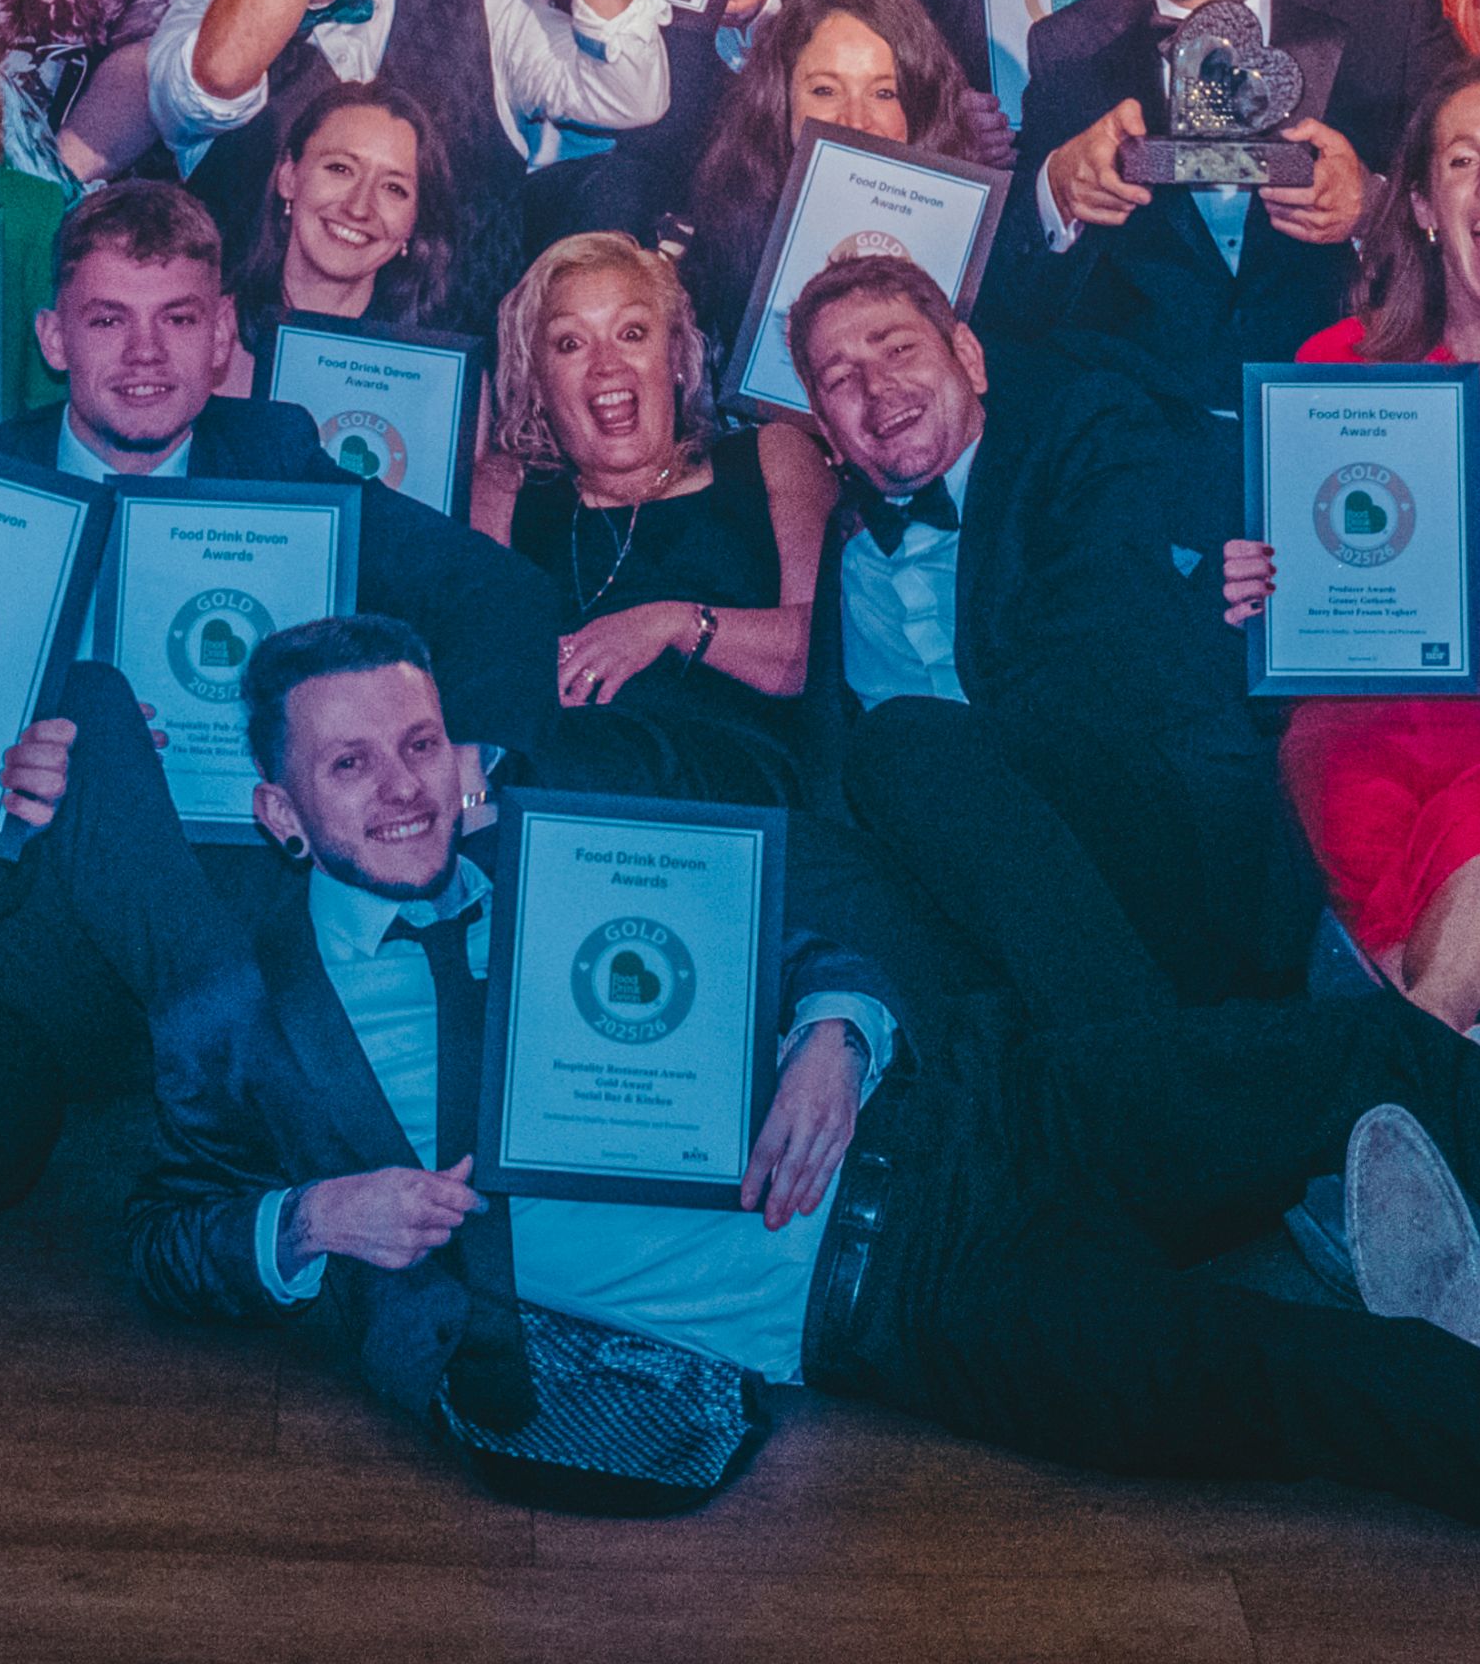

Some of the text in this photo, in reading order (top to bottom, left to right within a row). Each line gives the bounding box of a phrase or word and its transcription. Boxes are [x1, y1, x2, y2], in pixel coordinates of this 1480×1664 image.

[1308, 408, 1417, 420] Food Drink Devon
[1339, 425, 1387, 436] Awards
[1338, 466, 1390, 484] GOLD
[1335, 545, 1395, 565] 2025/26
[574, 846, 707, 871] Food Drink Devon
[609, 870, 668, 889] Awards
[605, 922, 669, 944] GOLD
[595, 1015, 667, 1041] 2025/26
